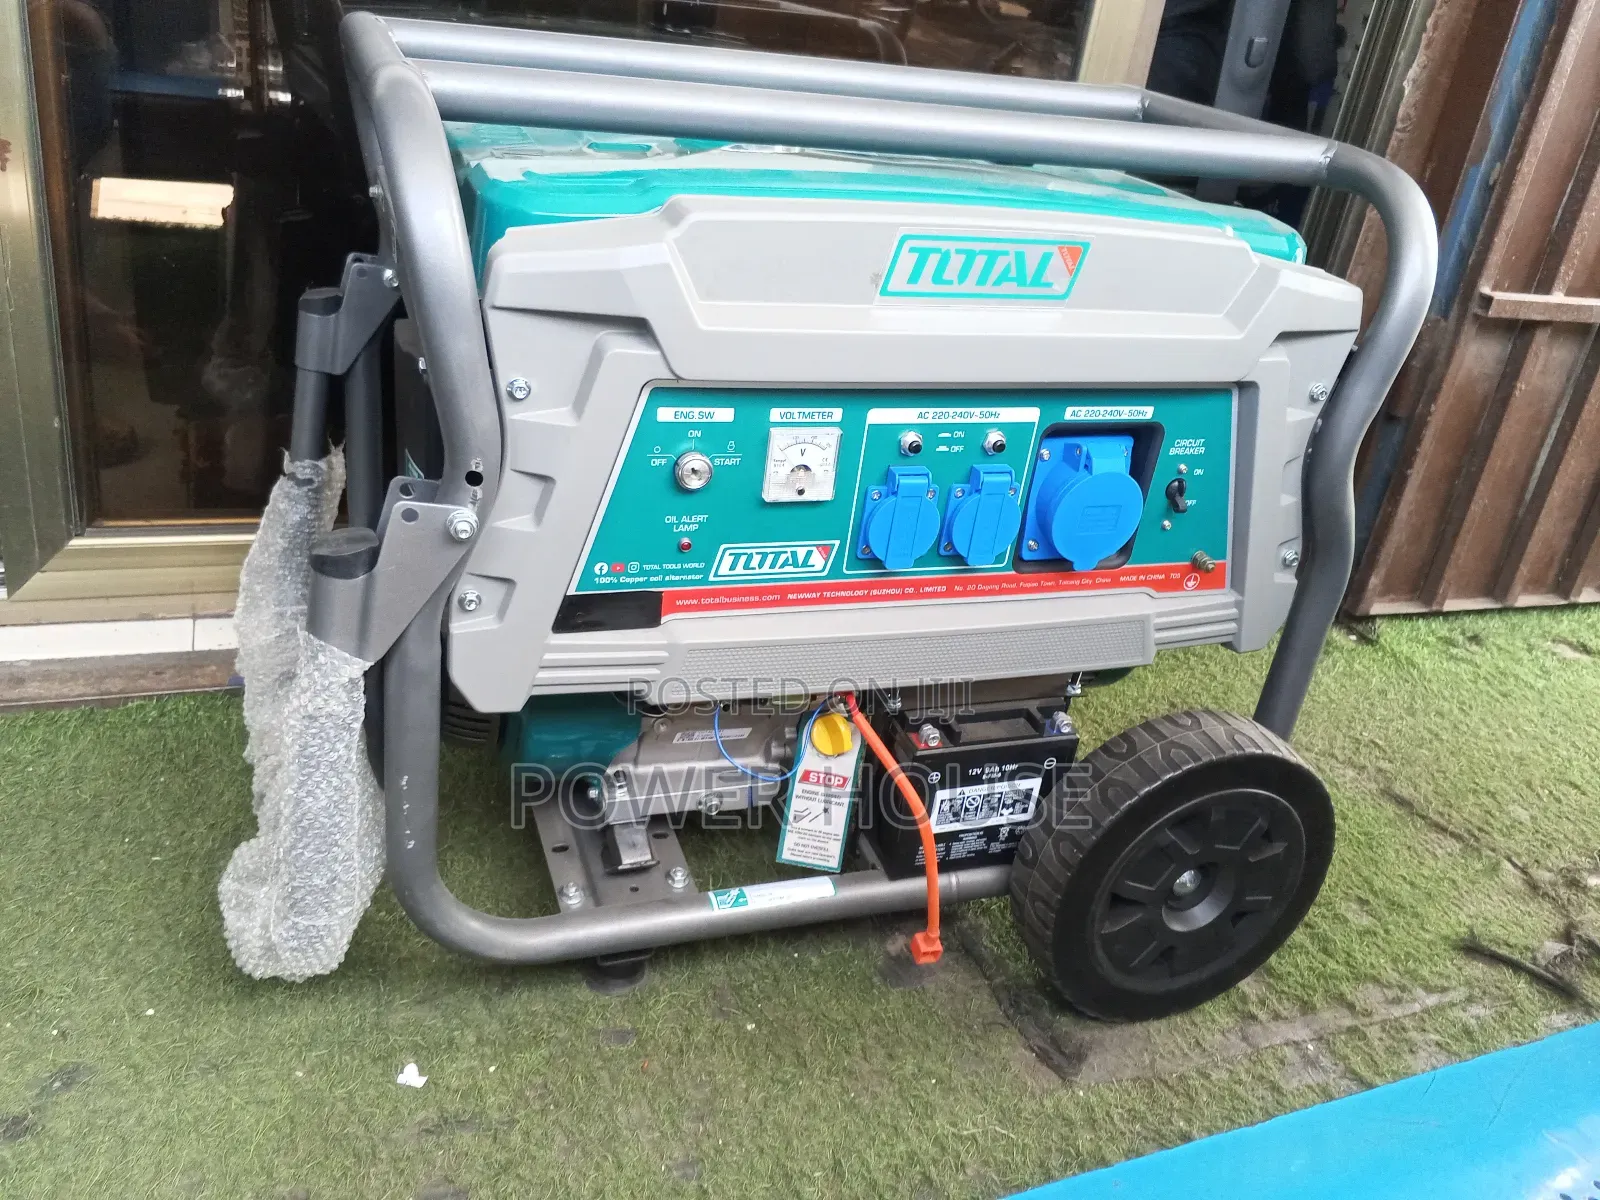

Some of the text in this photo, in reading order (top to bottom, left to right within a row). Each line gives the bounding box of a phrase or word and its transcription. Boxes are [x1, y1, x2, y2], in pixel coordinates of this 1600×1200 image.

[907, 246, 1054, 288] TOTAL
[673, 410, 715, 420] ENG.SW
[779, 411, 834, 420] VOLTMETER
[917, 411, 929, 420] AC
[1070, 409, 1081, 418] AC
[688, 430, 701, 438] ON
[1174, 438, 1205, 447] CIRCUIT
[800, 447, 806, 457] V
[950, 445, 964, 453] OFF
[1169, 447, 1205, 456] BREAKER
[651, 458, 667, 467] OFF
[714, 458, 741, 466] START
[1193, 468, 1204, 476] ON
[664, 514, 709, 524] OIL ALERT
[673, 524, 698, 532] LAMP
[728, 549, 815, 572] TOTAL
[594, 576, 618, 585] 100%
[620, 575, 648, 584] Copper
[649, 574, 663, 582] coil
[823, 589, 869, 598] TECHNOLOGY
[675, 594, 781, 606] www.totalbusiness.com
[968, 767, 983, 776] 12V
[808, 771, 844, 787] STOP
